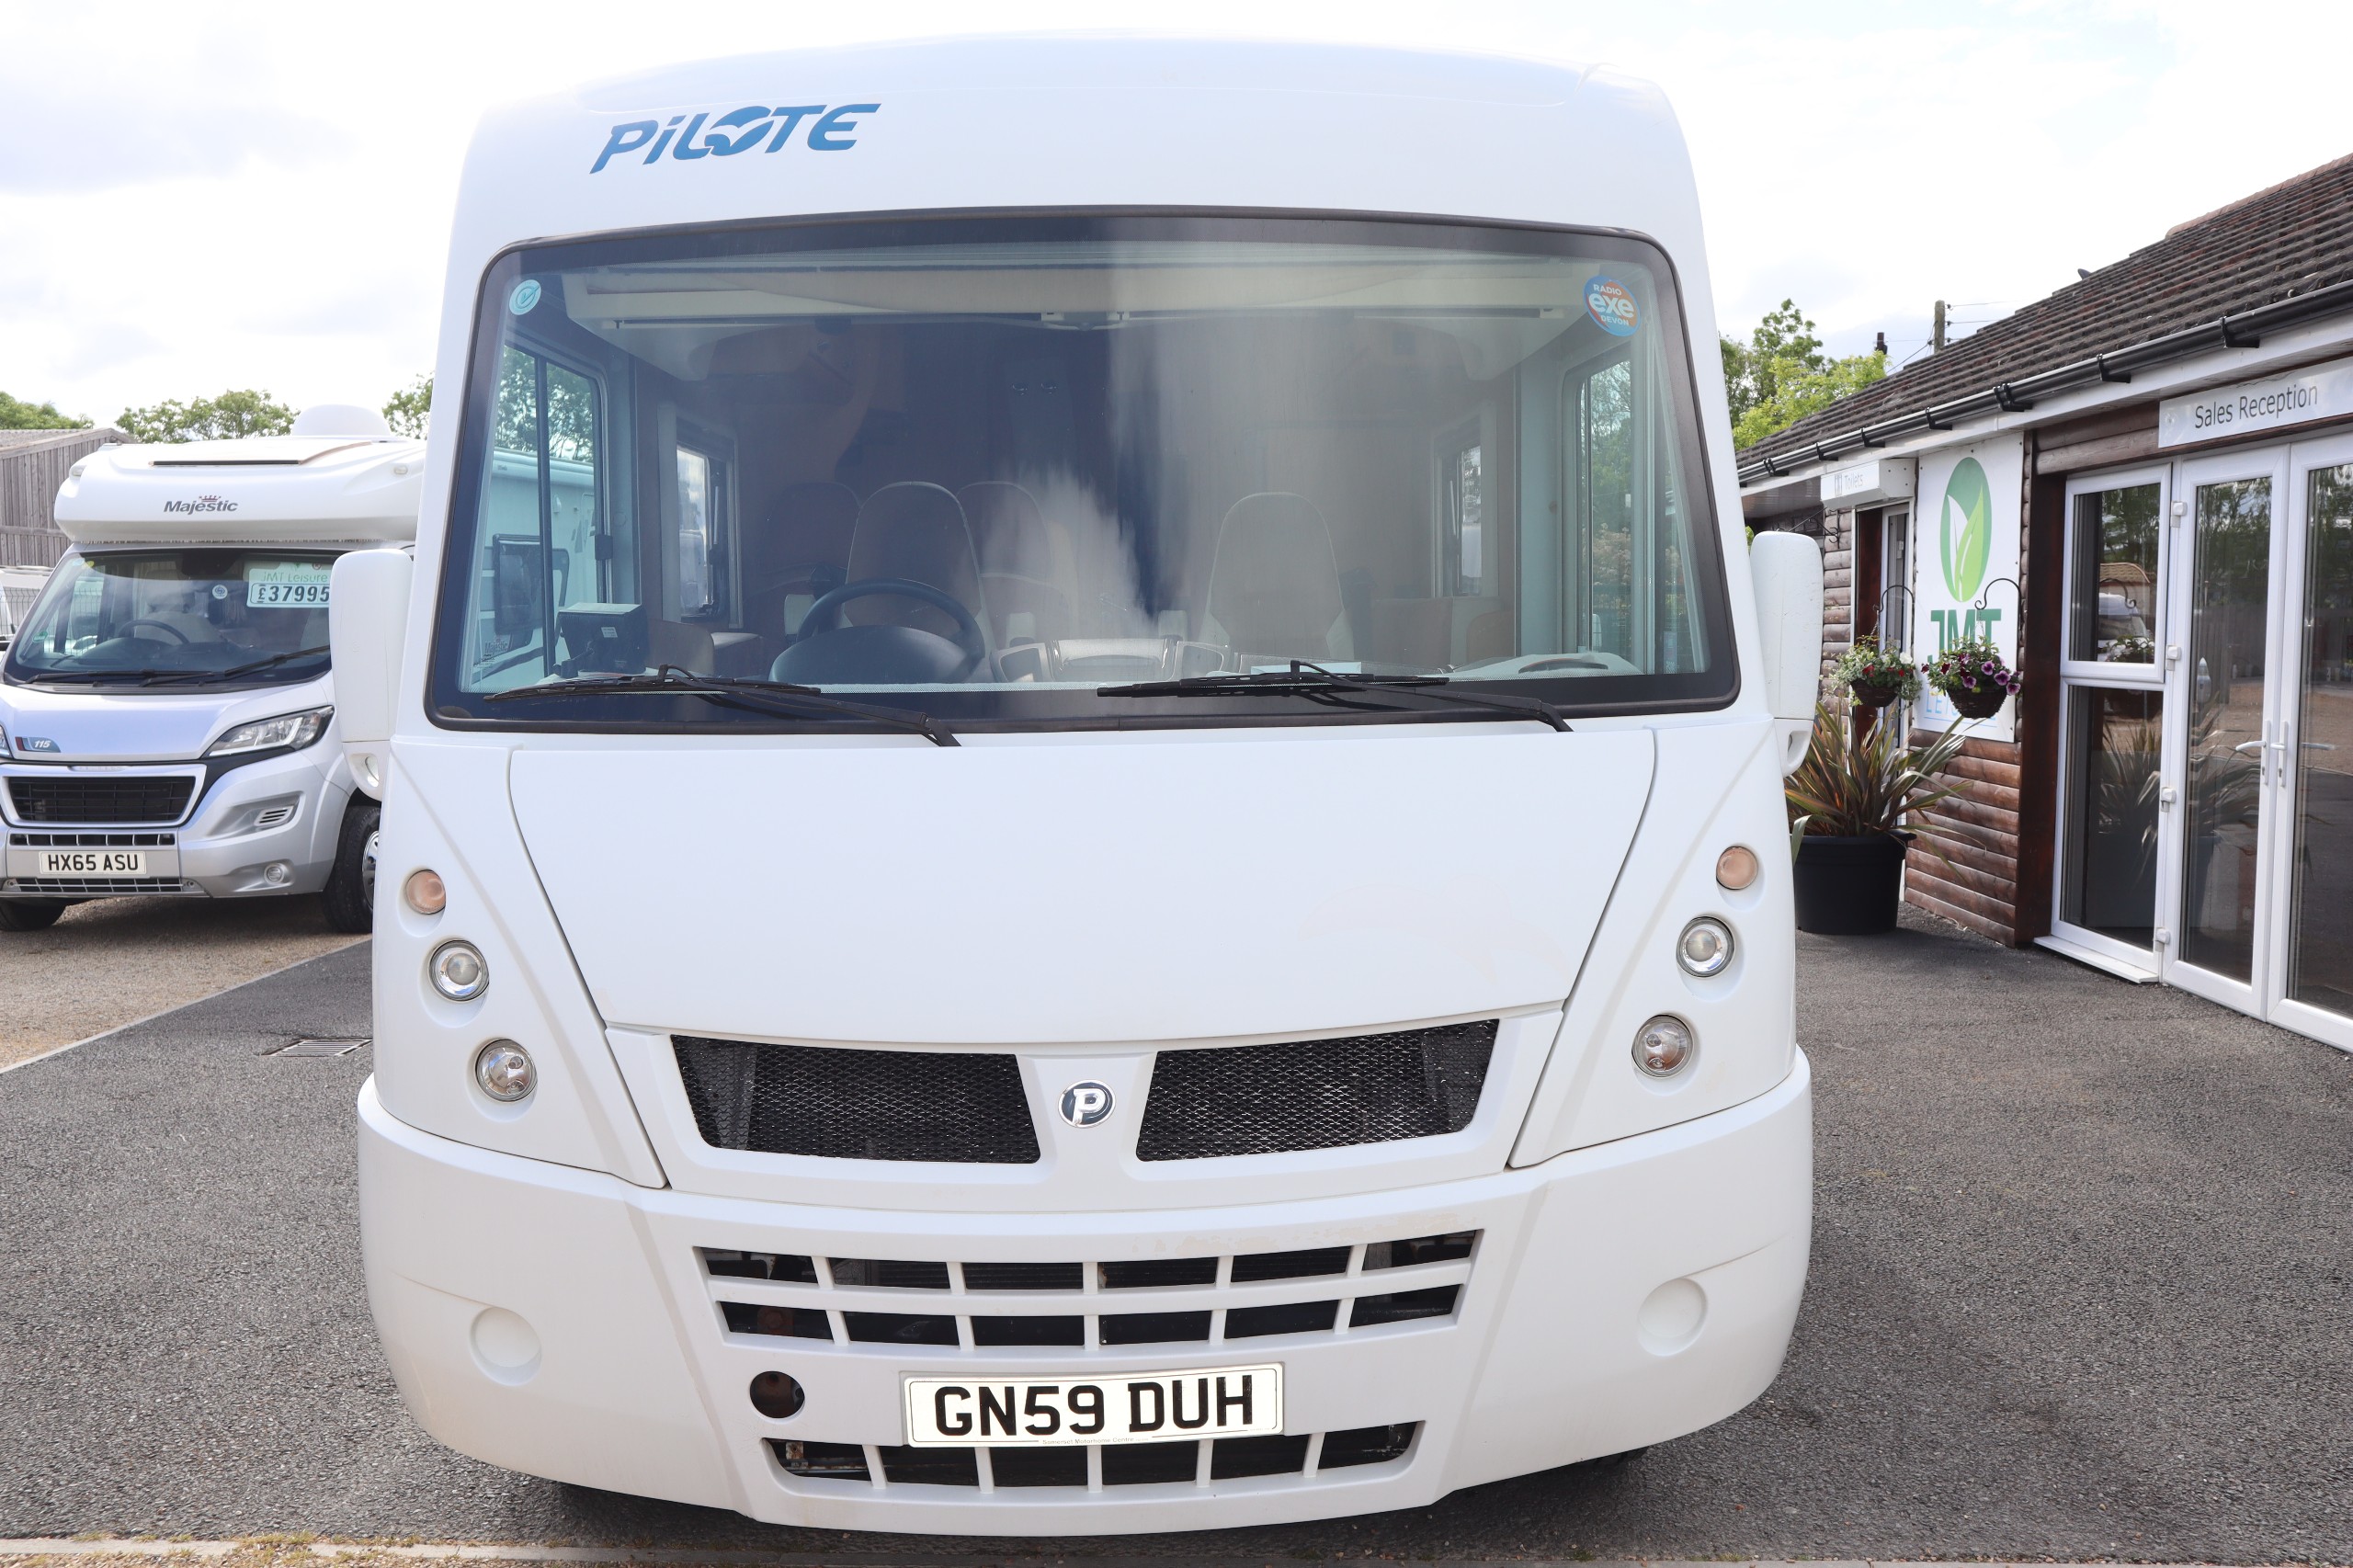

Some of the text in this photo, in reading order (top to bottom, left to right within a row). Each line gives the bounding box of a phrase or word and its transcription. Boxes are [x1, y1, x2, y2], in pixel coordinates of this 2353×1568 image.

[1593, 284, 1622, 296] RADIO
[1588, 293, 1634, 318] exe
[1600, 314, 1630, 325] DEVON
[2195, 384, 2318, 428] Sales Reception
[1844, 472, 1864, 490] Toilets
[164, 500, 239, 515] Majestic
[288, 573, 328, 583] Leisure
[256, 585, 330, 603] £37995
[1927, 608, 2002, 665] JMT
[34, 740, 51, 748] 115
[48, 854, 139, 871] HX65 ASU
[934, 1374, 1253, 1437] GN59 DUH
